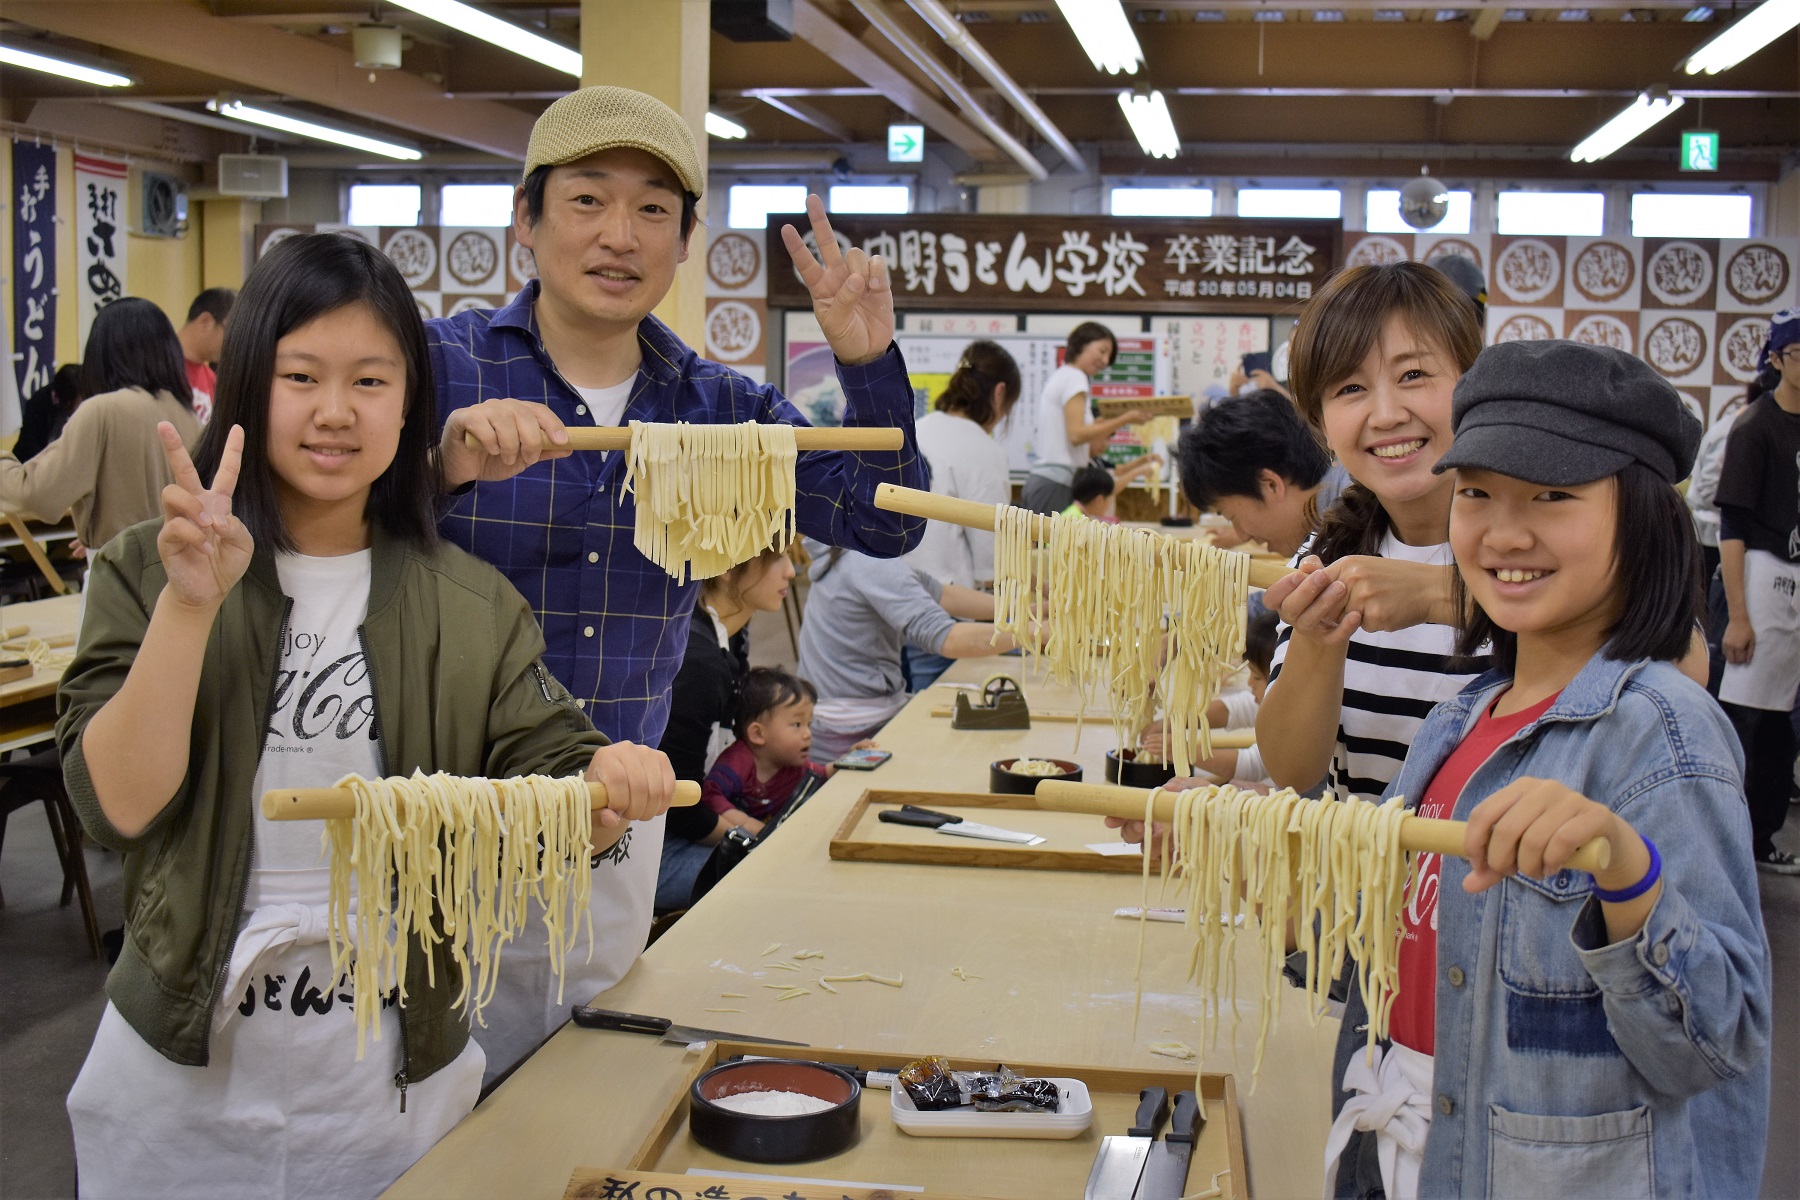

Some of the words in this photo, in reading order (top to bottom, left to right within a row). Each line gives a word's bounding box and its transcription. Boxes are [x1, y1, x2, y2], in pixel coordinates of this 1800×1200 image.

[20, 164, 50, 400] 手打うどん
[862, 230, 1149, 297] 中野うどん学校
[1164, 233, 1316, 275] 卒業記念
[1164, 279, 1312, 299] 平成30年05月04日
[281, 627, 326, 657] joy
